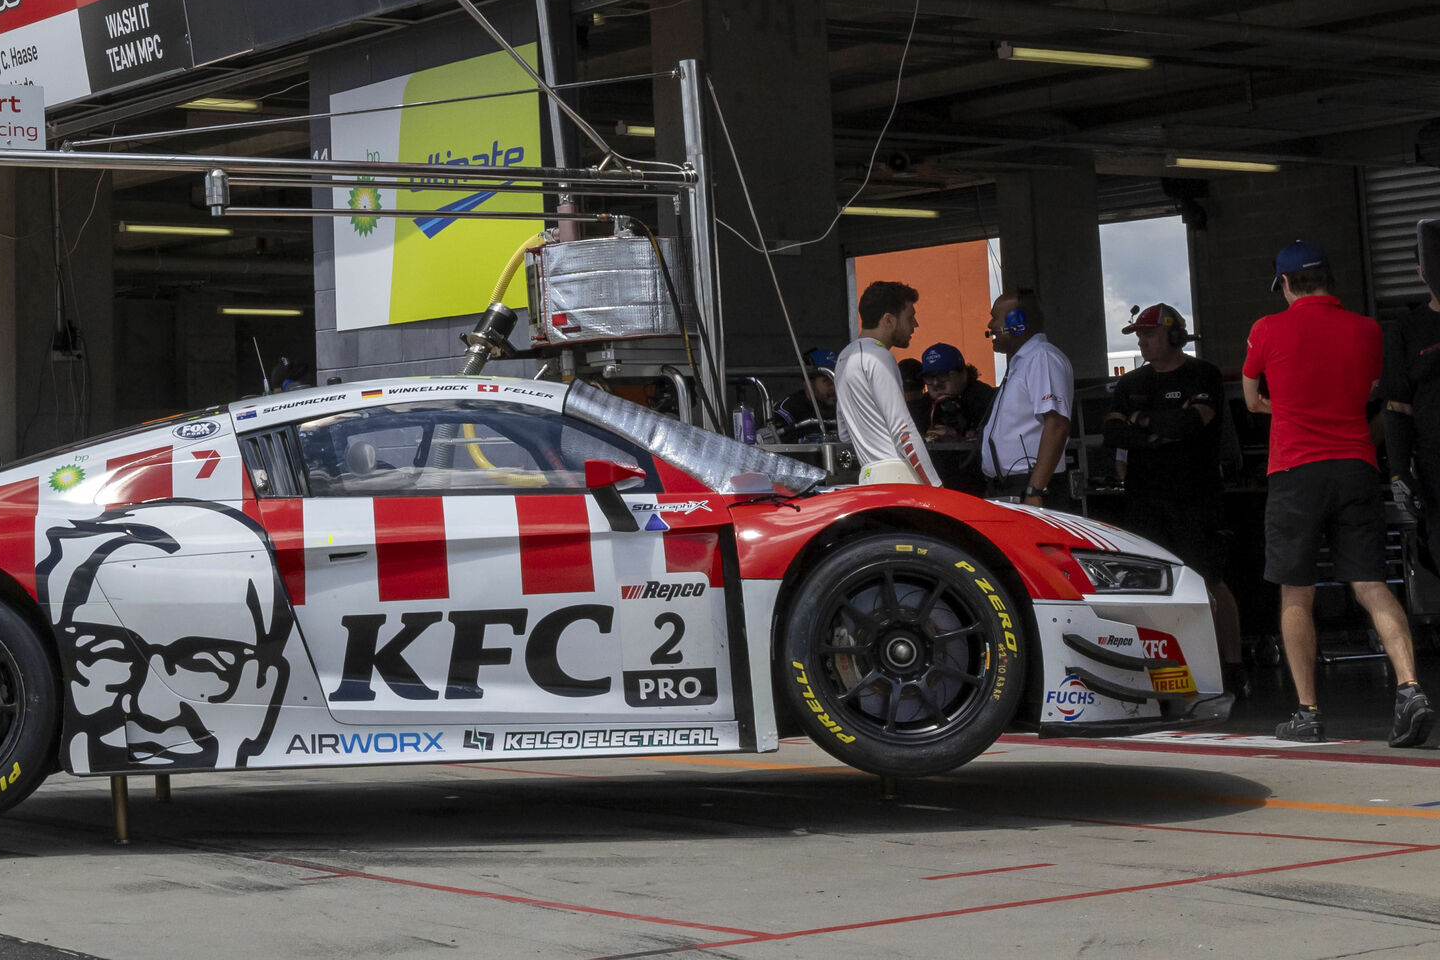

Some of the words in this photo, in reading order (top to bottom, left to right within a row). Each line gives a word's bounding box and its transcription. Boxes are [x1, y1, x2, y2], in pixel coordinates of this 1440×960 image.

[106, 8, 138, 39] WASH
[138, 3, 150, 29] IT
[1, 52, 10, 70] C.
[11, 44, 38, 68] Haase
[106, 40, 136, 72] TEAM
[137, 34, 163, 64] MPC
[263, 394, 347, 414] SCHUMACHER
[388, 385, 469, 395] WINKELHOCK
[504, 387, 554, 399] FELLER
[182, 423, 210, 433] FOX
[642, 581, 706, 601] Repco
[650, 613, 686, 665] 2
[1107, 636, 1134, 647] Repco
[1141, 640, 1168, 659] KFC
[328, 604, 615, 702] KFC
[639, 675, 702, 700] PRO
[1046, 691, 1095, 704] FUCHS
[792, 661, 856, 744] PIRELLI
[285, 732, 446, 755] AIRWORX
[504, 731, 579, 750] KELSO
[581, 728, 719, 748] ELECTRICAL
